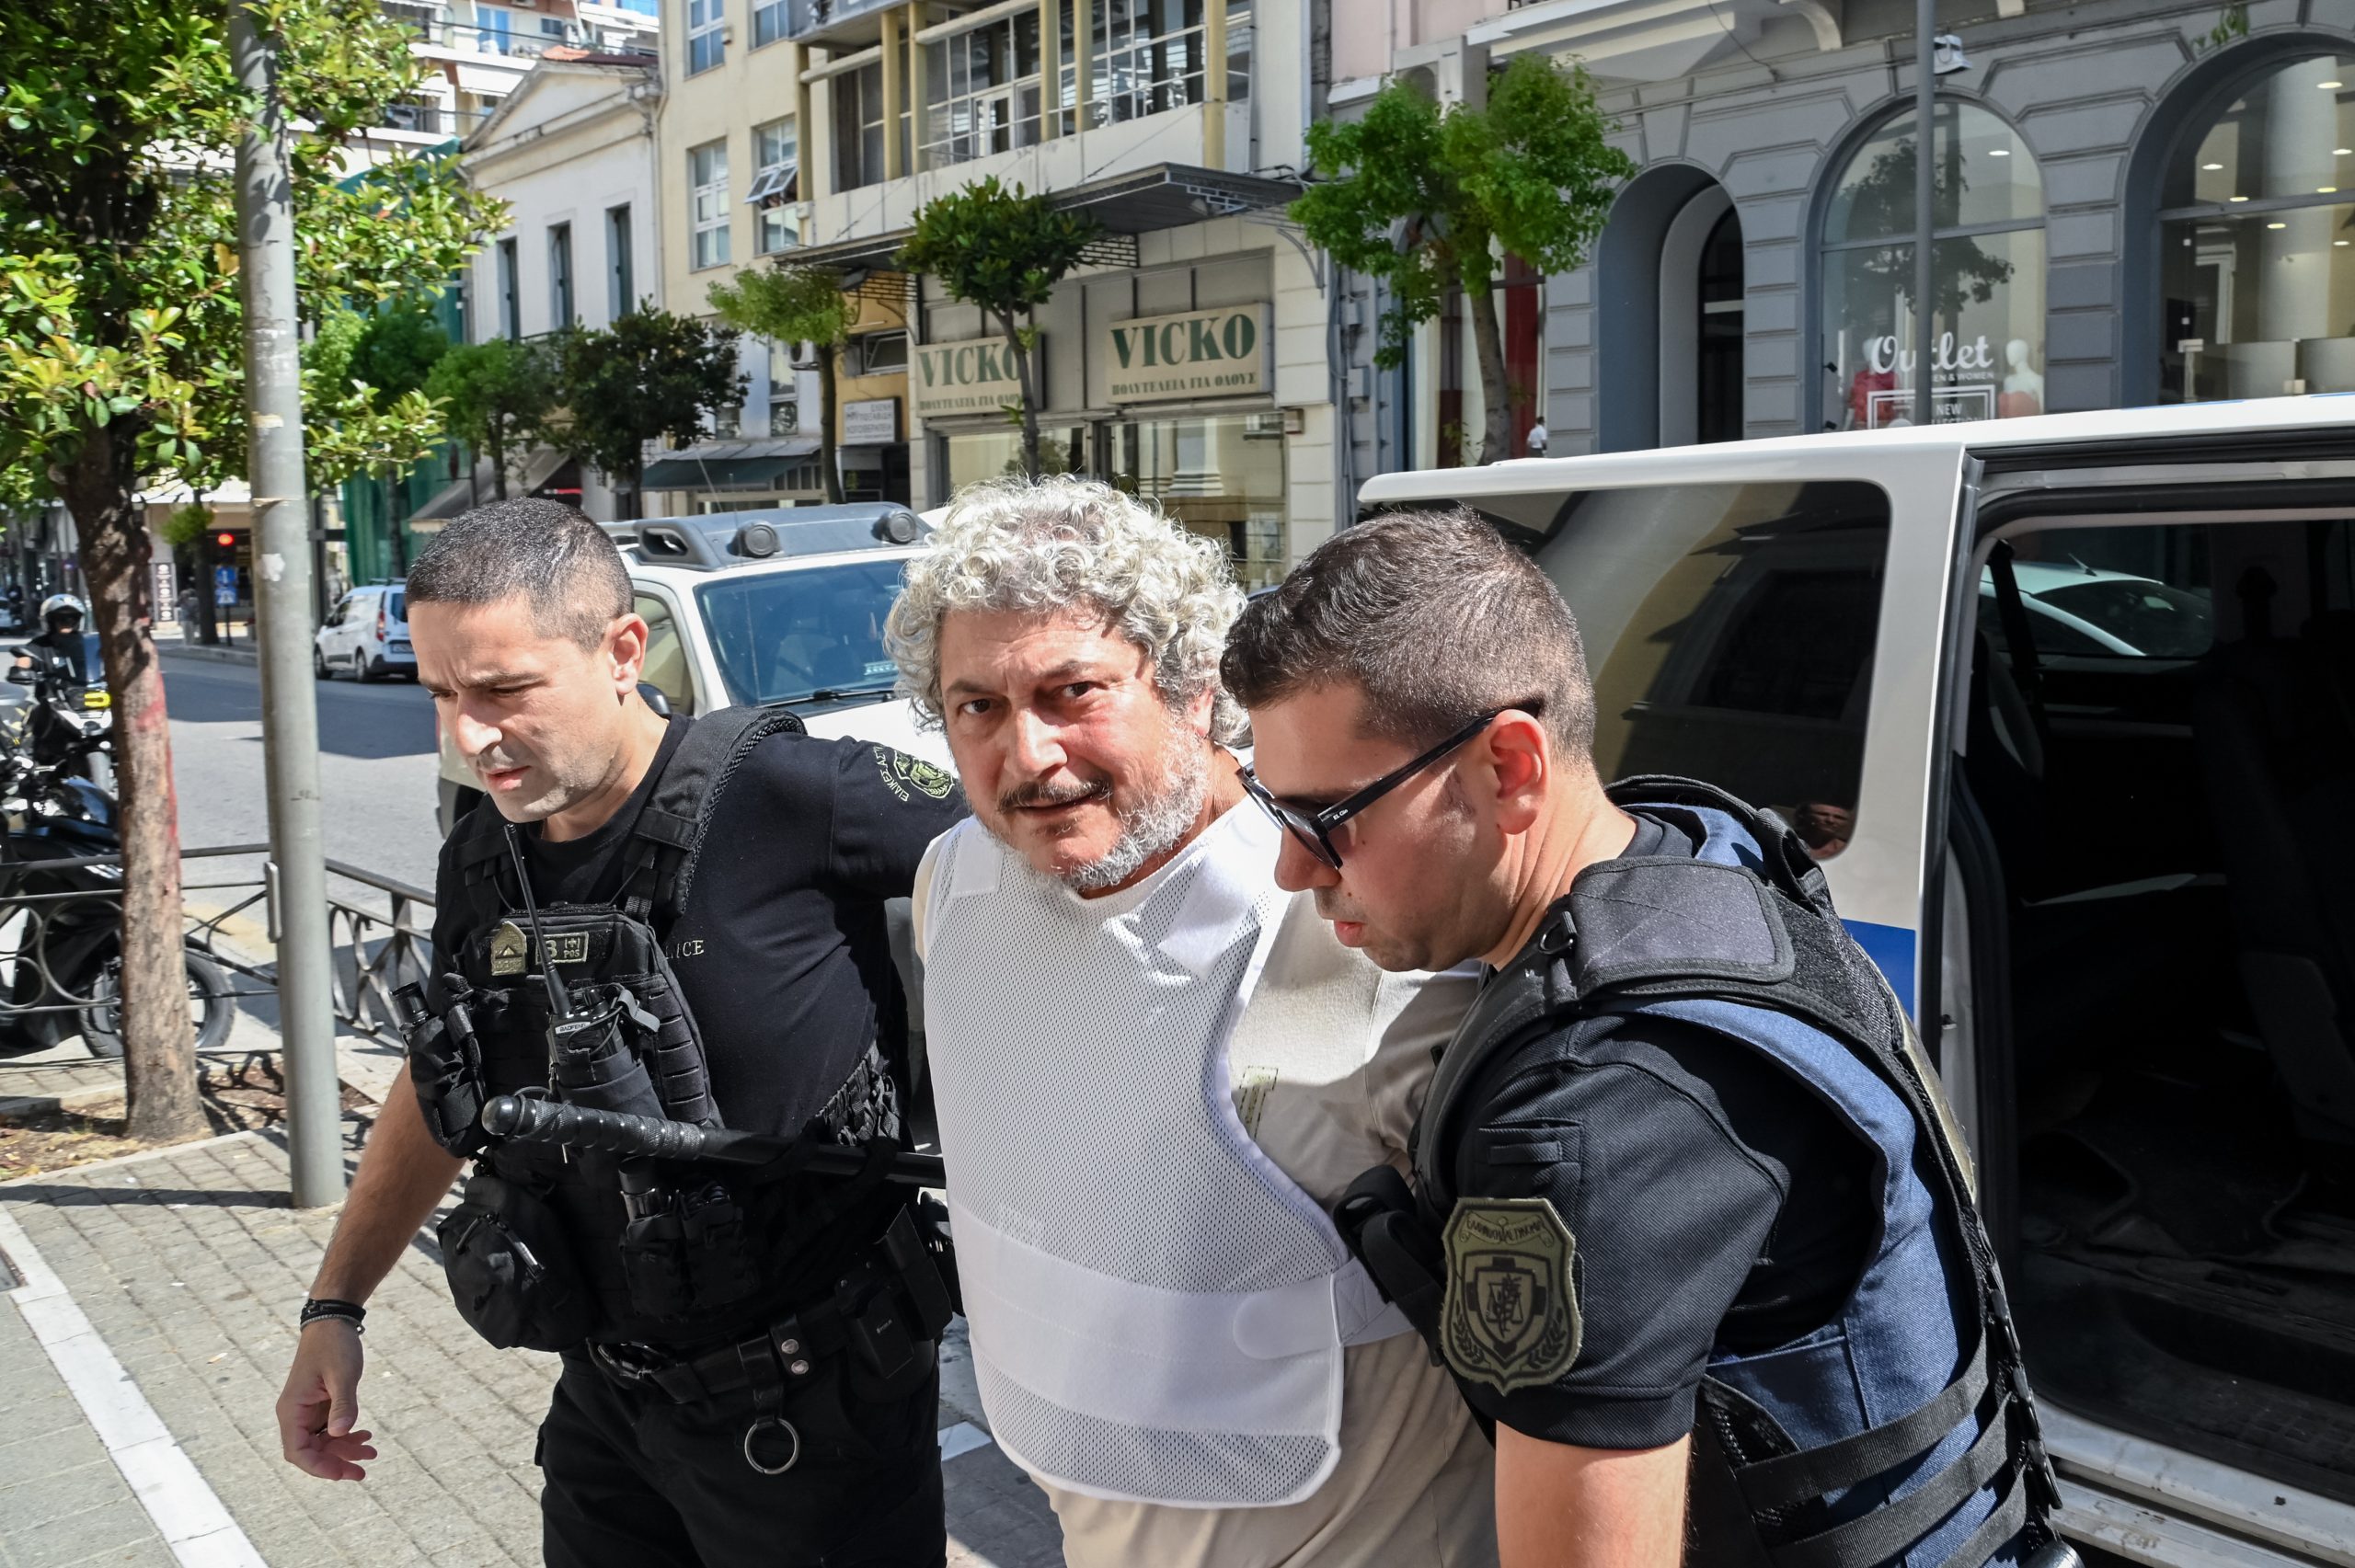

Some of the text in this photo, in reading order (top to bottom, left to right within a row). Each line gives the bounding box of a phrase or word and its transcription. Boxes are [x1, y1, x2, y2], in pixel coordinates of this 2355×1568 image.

[1111, 314, 1256, 369] VICKO
[1872, 331, 1993, 373] Oulet
[918, 343, 1020, 387] VICKO
[1111, 372, 1256, 395] ΠΟΛΥΤΕΛΕΙΑ ΓΙΑ ΟΛΟΥΣ
[1957, 372, 1994, 381] WOMEN
[1936, 403, 1962, 415] NEW
[563, 949, 580, 958] POS
[665, 939, 705, 959] LICE
